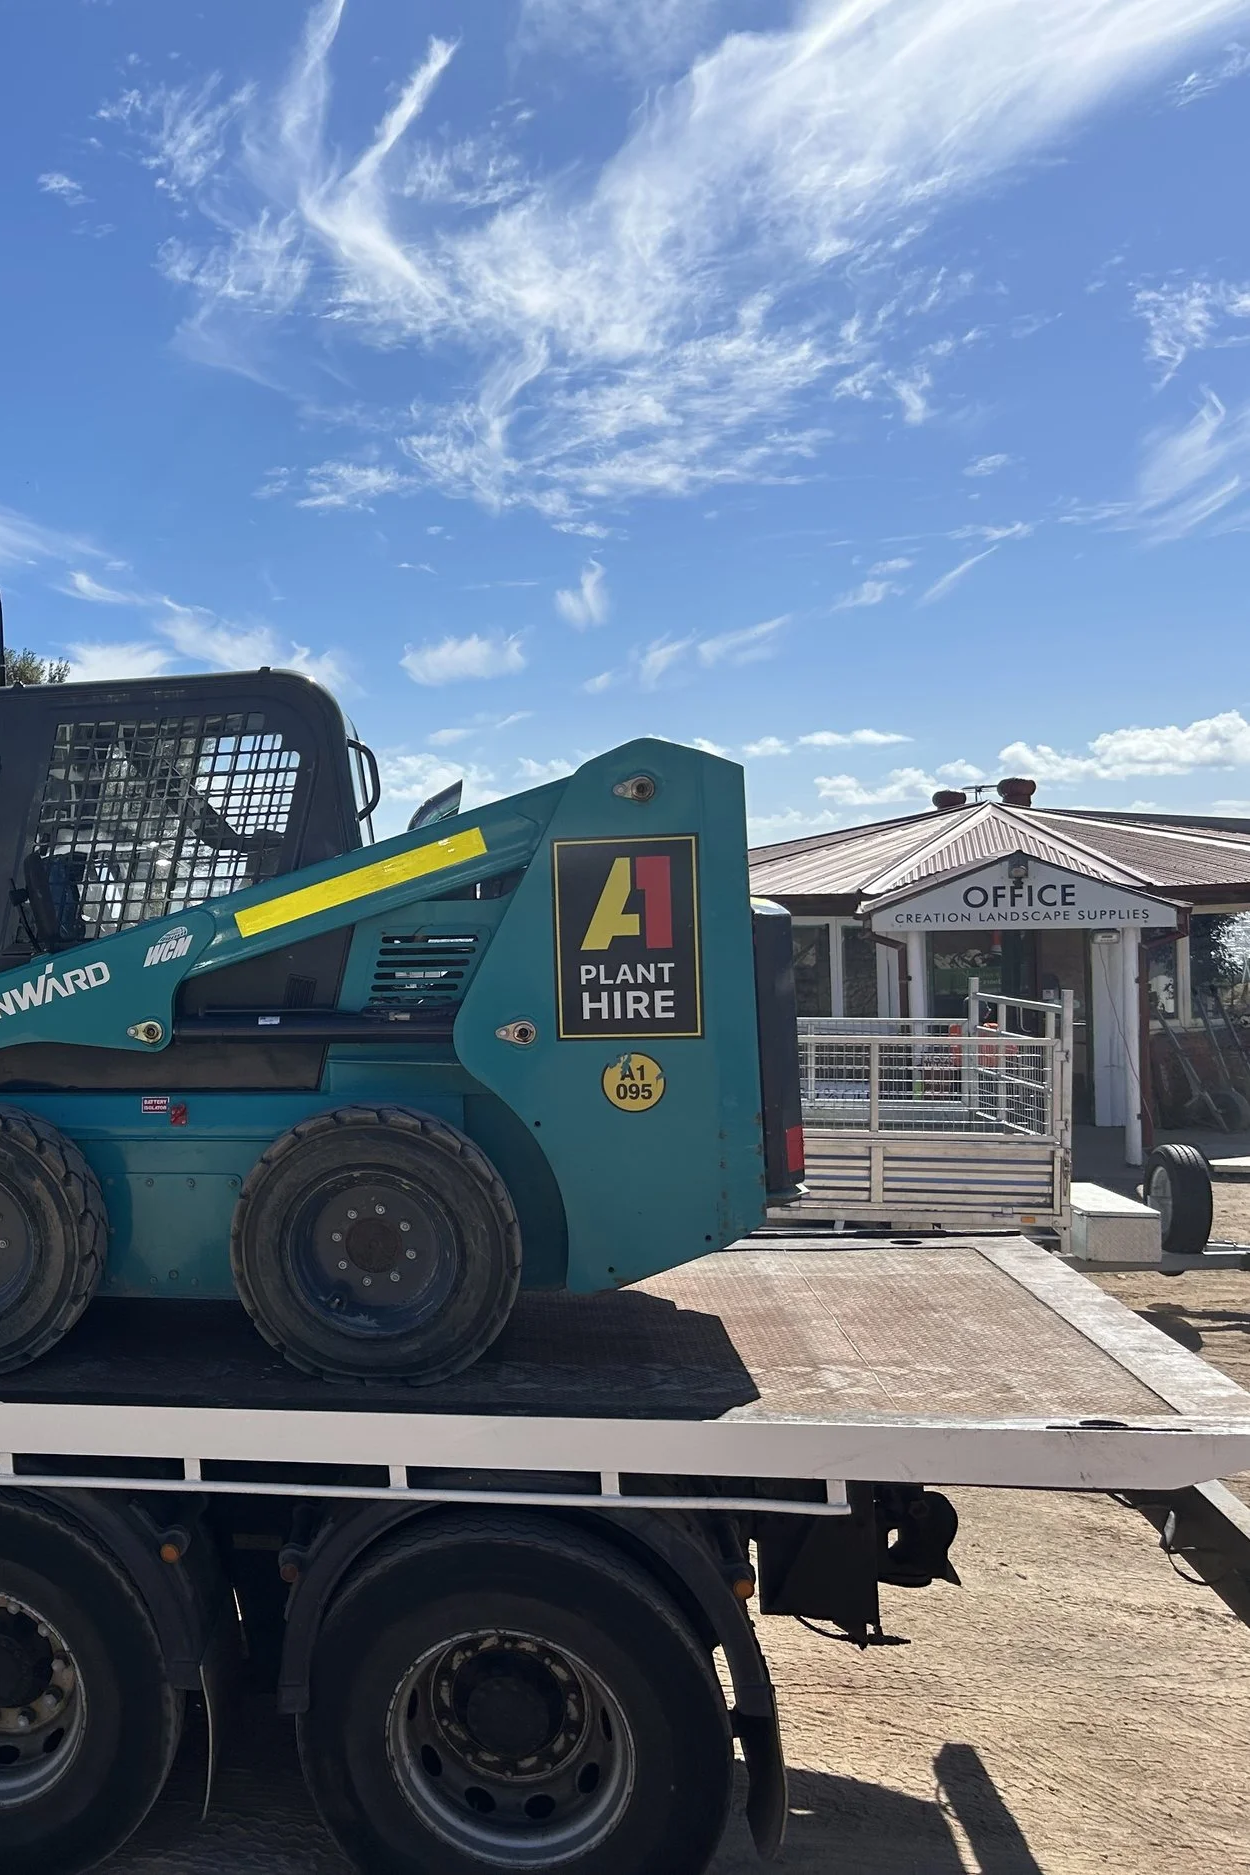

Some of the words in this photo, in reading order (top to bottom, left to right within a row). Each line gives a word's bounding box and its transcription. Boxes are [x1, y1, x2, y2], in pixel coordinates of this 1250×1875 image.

[580, 856, 673, 950] A1
[962, 884, 1076, 908] OFFICE
[895, 912, 971, 923] CREATION
[979, 911, 1070, 922] LANDSCAPE
[1078, 909, 1150, 920] SUPPLIES
[580, 963, 675, 985] PLANT
[582, 990, 675, 1020] HIRE
[620, 1065, 645, 1081] A1
[616, 1084, 653, 1101] 095
